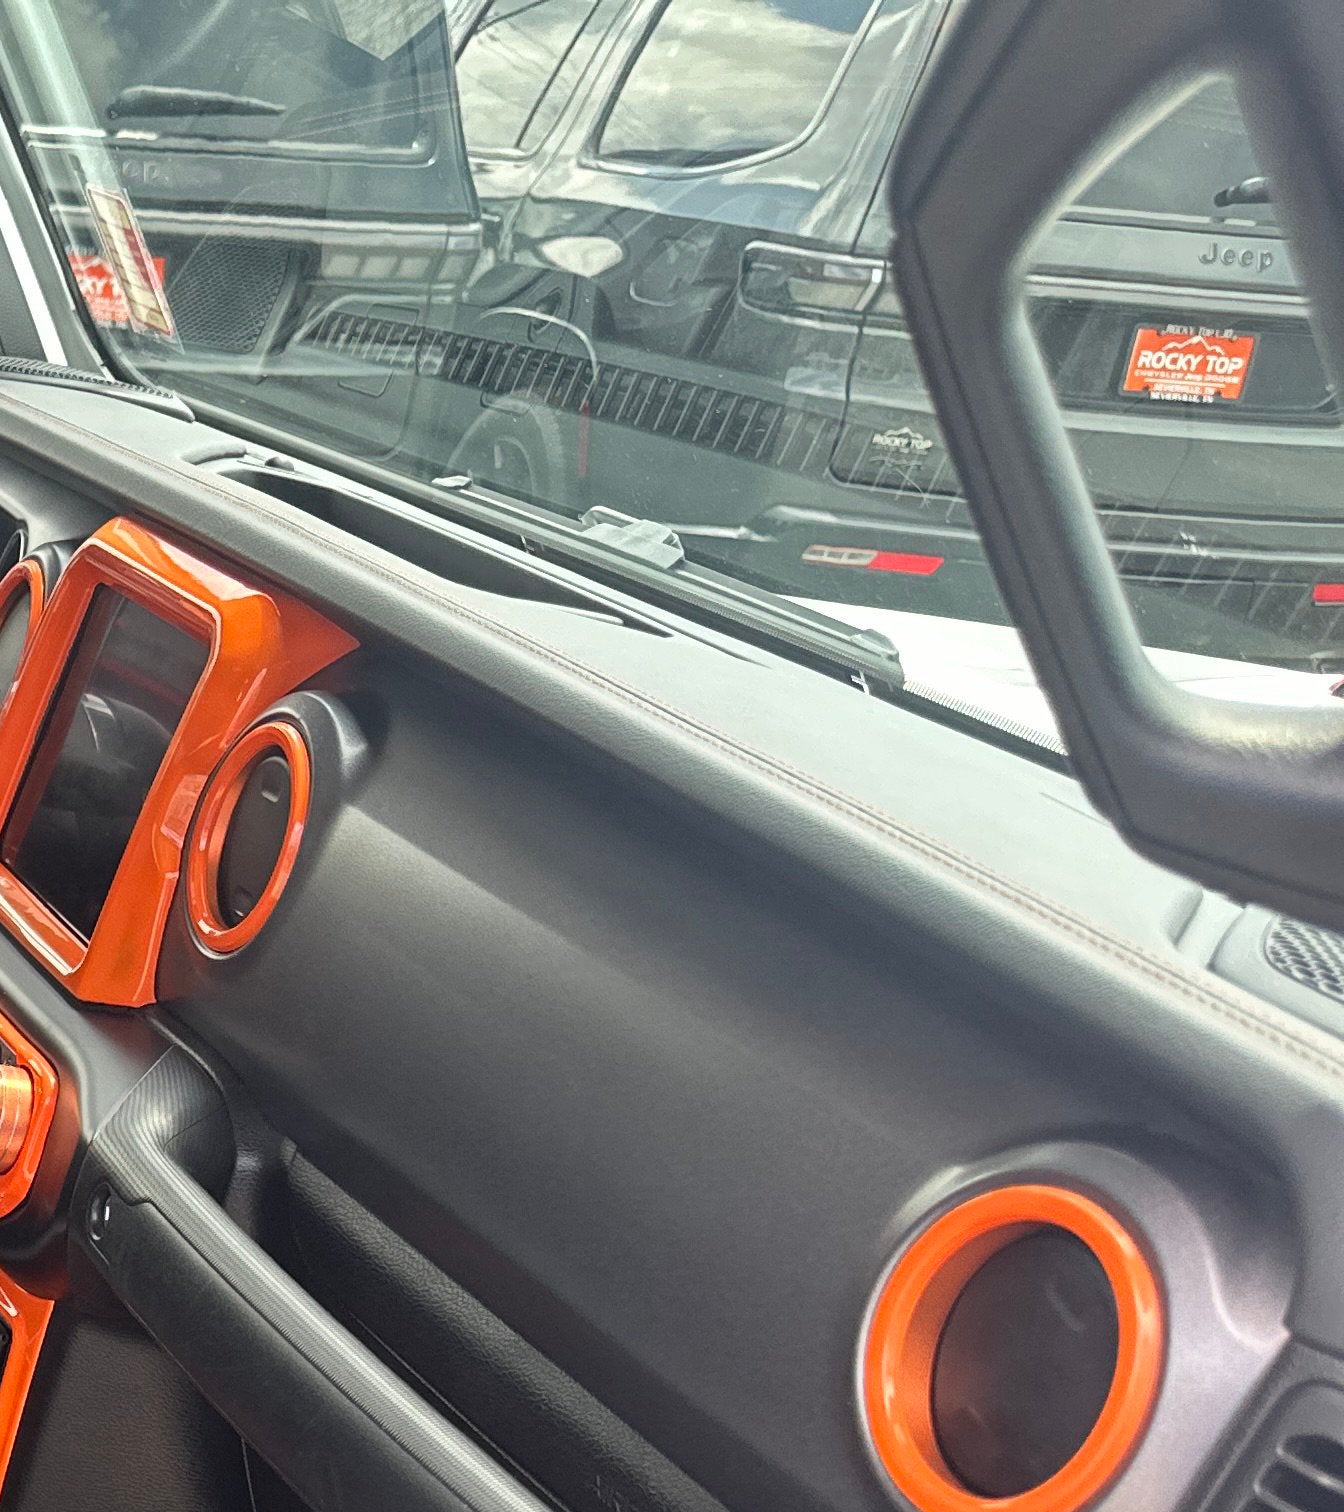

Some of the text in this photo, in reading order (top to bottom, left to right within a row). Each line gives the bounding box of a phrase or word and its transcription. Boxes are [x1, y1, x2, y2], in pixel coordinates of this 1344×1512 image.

[1198, 242, 1273, 273] Jeep
[1137, 350, 1243, 374] ROCKY TOP
